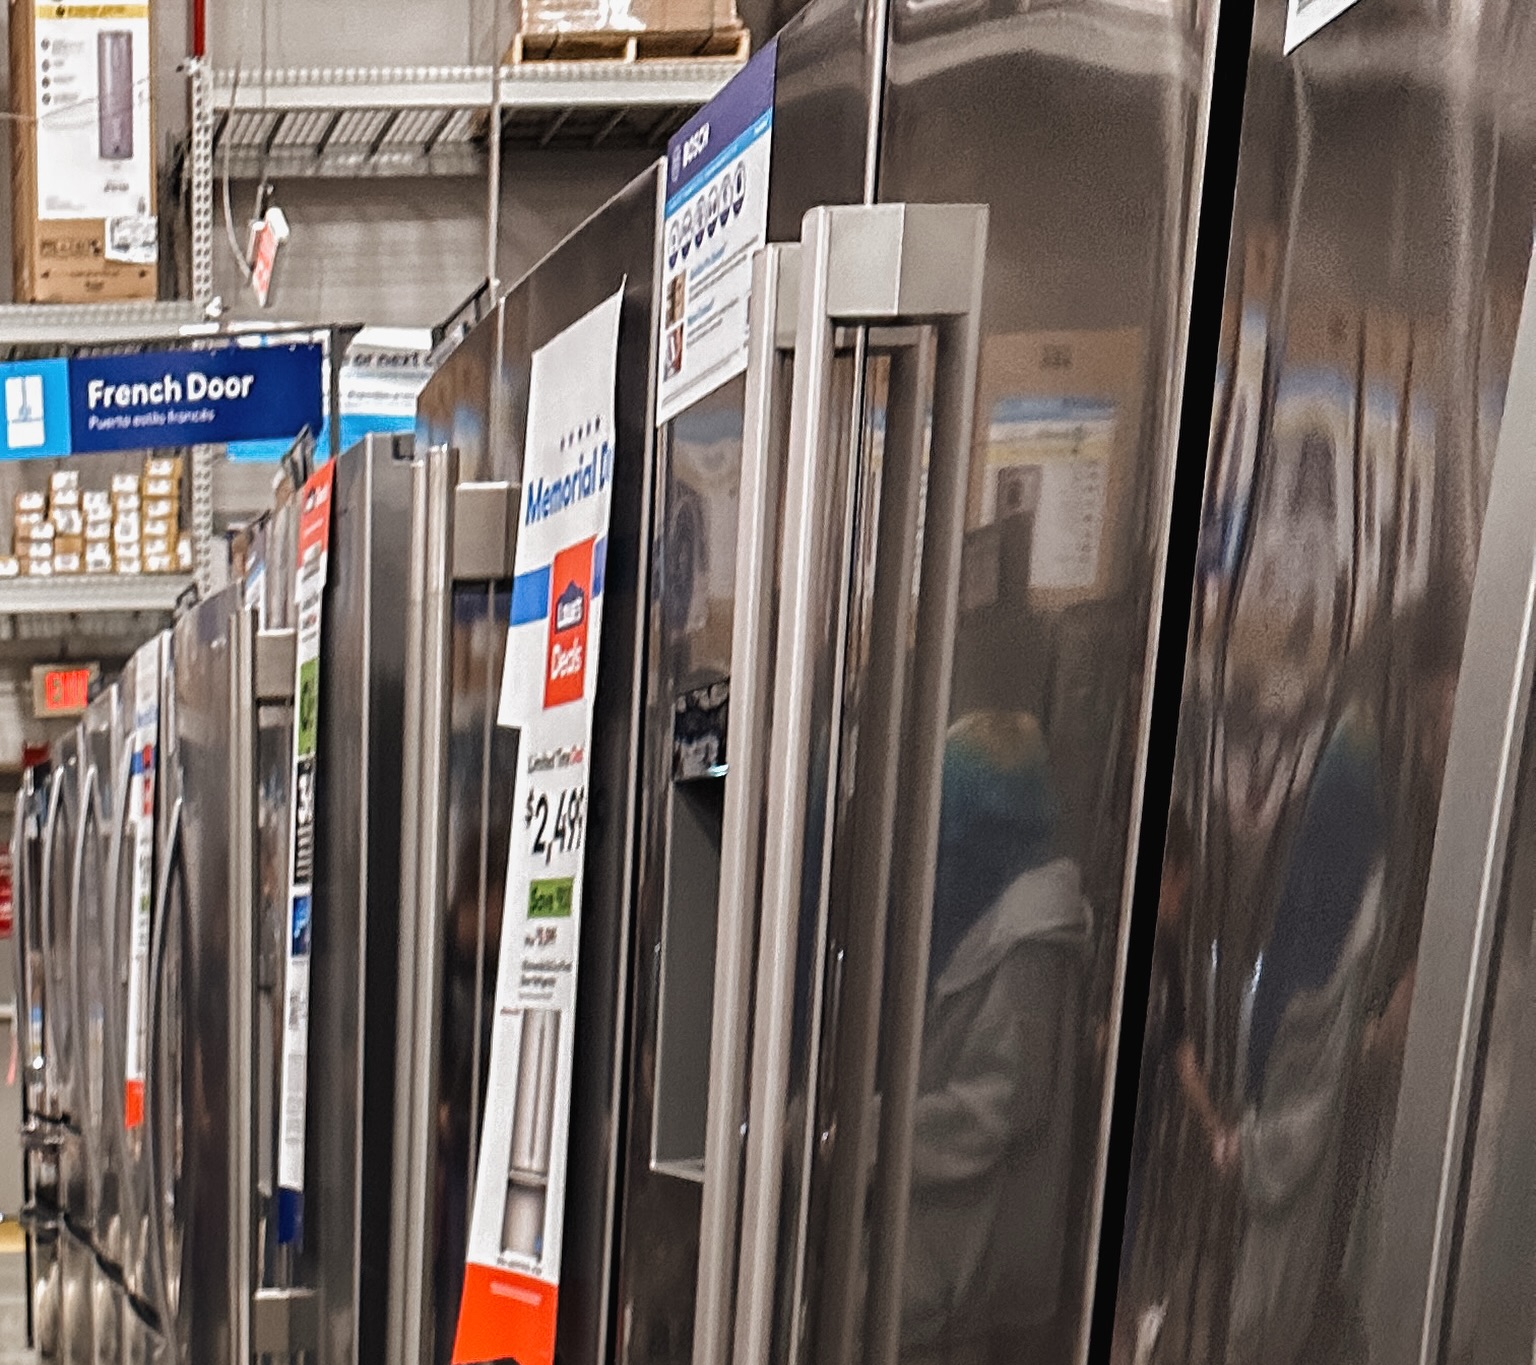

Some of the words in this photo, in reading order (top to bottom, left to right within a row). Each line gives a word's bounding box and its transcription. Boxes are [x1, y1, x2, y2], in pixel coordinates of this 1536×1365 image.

[88, 373, 183, 410] French
[186, 371, 254, 402] Door
[525, 447, 598, 527] Memorial
[550, 636, 583, 681] Deals
